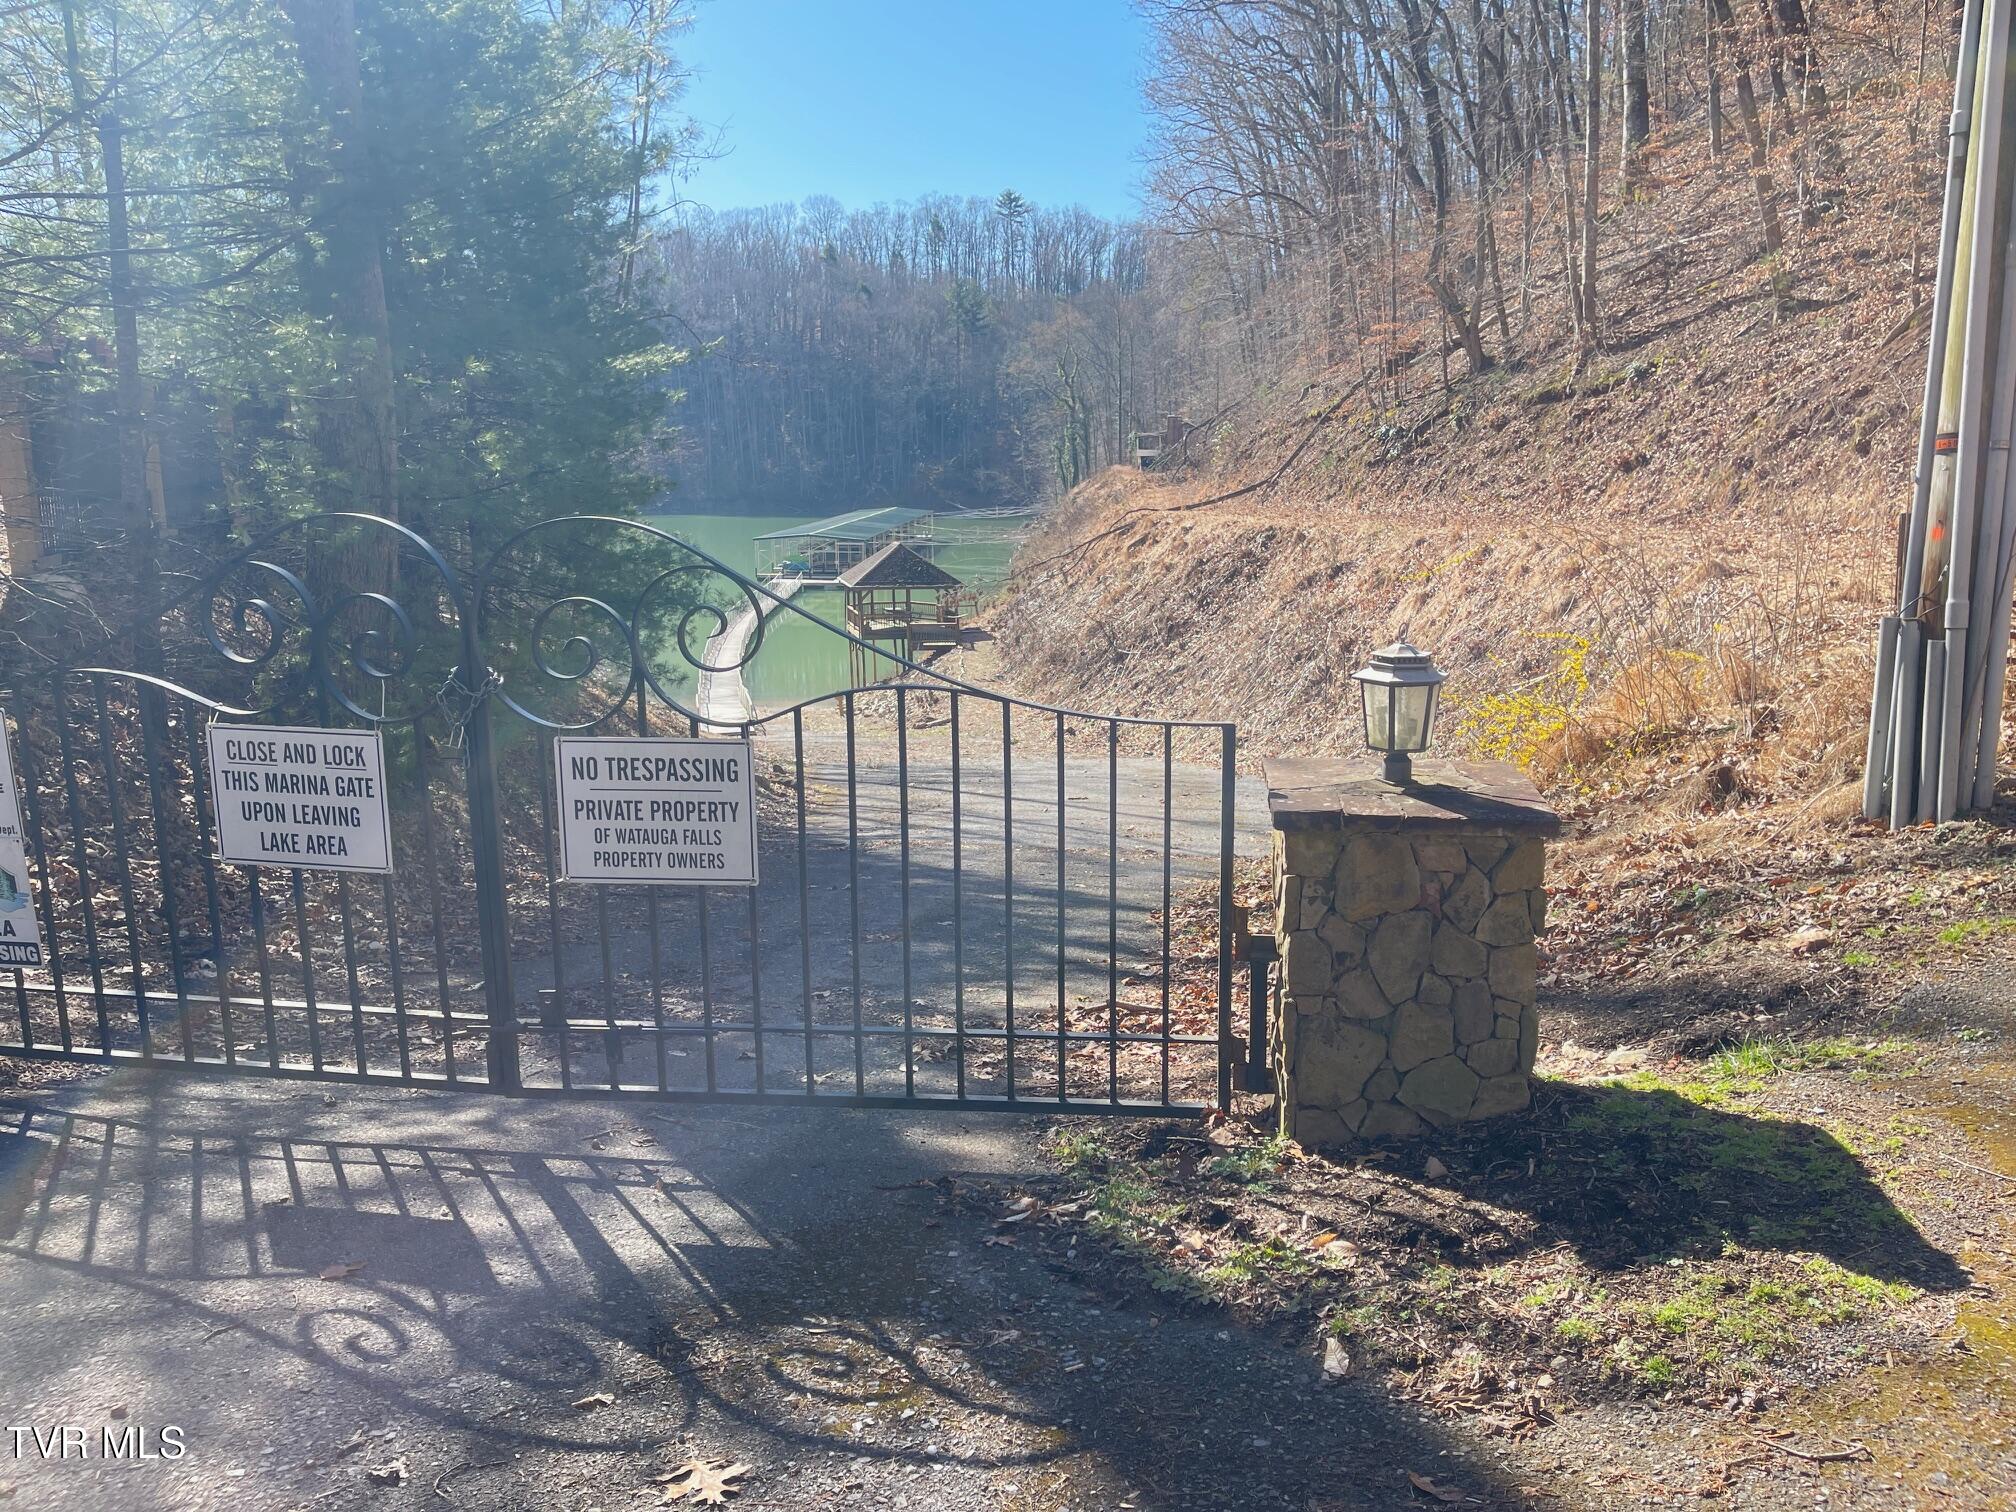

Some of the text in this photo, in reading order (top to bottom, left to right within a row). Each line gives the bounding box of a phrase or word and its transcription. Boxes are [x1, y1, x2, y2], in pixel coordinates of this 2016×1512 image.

[226, 740, 366, 767] CLOSE AND LOCK
[571, 756, 739, 783] NO TRESPASSING
[222, 770, 375, 798] THIS MARINA GATE
[241, 801, 361, 827] UPON LEAVING
[574, 800, 739, 822] PRIVATE PROPERTY
[260, 832, 348, 856] LAKE AREA
[594, 827, 722, 846] OF WATAUGA FALLS
[594, 851, 725, 869] PROPERTY OWNERS
